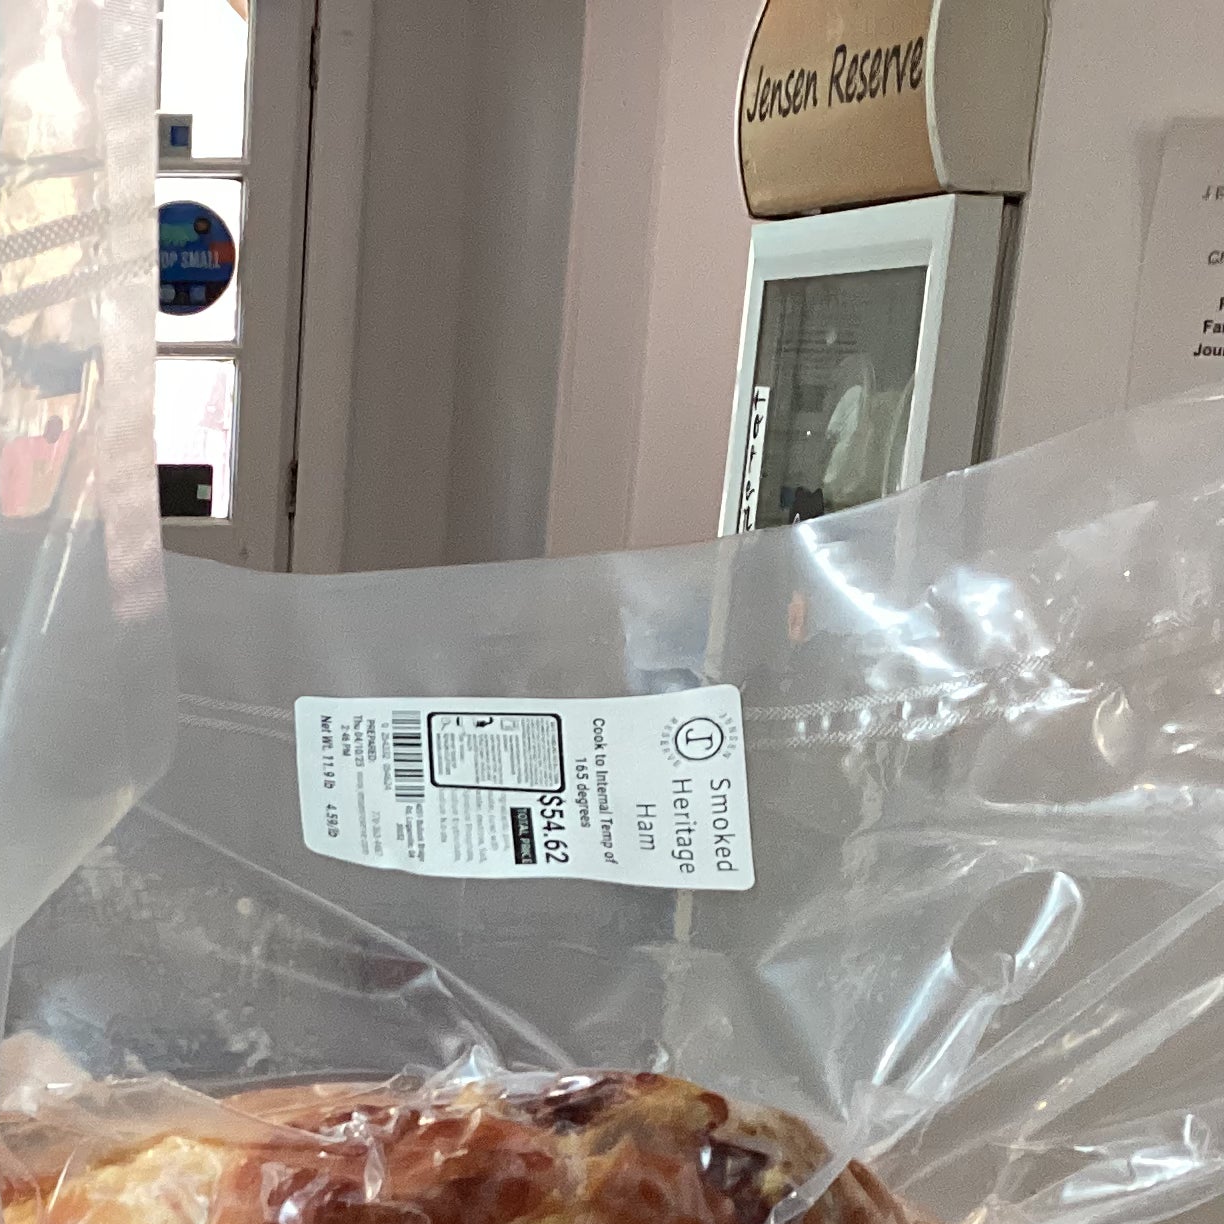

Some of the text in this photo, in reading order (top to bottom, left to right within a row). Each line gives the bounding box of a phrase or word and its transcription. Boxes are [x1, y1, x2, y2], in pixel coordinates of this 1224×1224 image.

[747, 36, 924, 122] Jensen Reserve
[1194, 343, 1224, 356] Jou
[1203, 319, 1224, 334] Fa
[319, 714, 336, 789] Net Wt. 11.9 lb
[341, 743, 351, 757] PM
[352, 714, 363, 731] Thu
[325, 803, 340, 838] 4.59/lb
[574, 757, 591, 828] 165 degrees
[592, 717, 617, 864] Cook to Internal Temp of
[516, 807, 532, 863] TOTAL PRICE
[536, 794, 569, 863] $54.62
[635, 803, 659, 851] Ham
[666, 778, 699, 873] Heritage
[709, 778, 738, 872] Smoked
